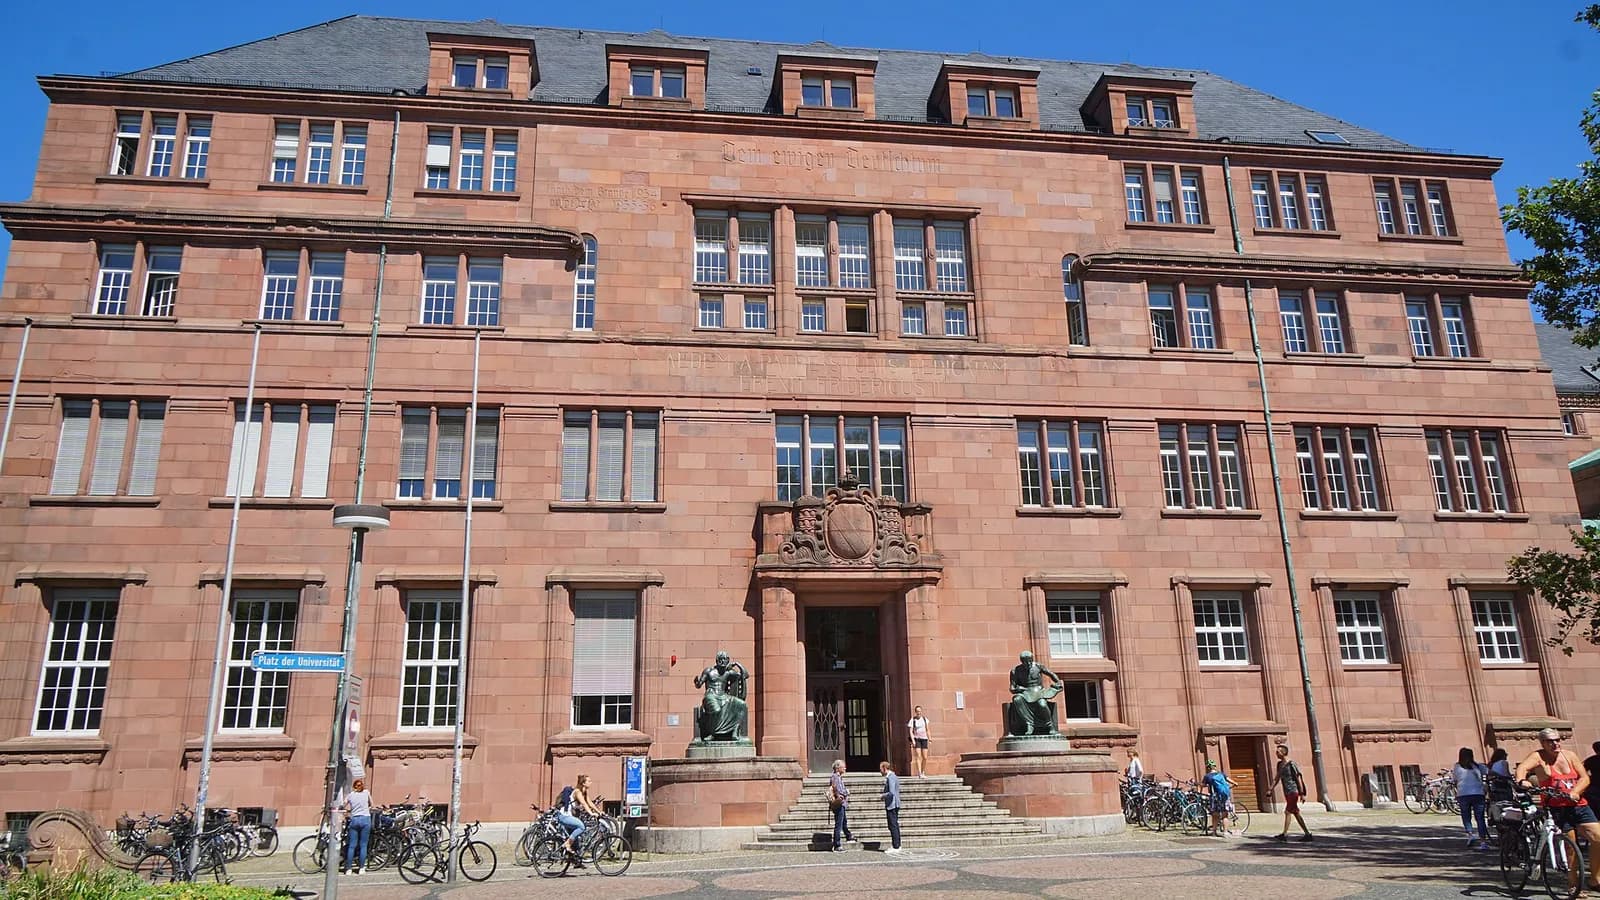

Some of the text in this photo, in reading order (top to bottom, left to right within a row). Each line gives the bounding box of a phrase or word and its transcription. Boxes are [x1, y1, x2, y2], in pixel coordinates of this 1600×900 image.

[258, 655, 340, 668] Platz der Universität
